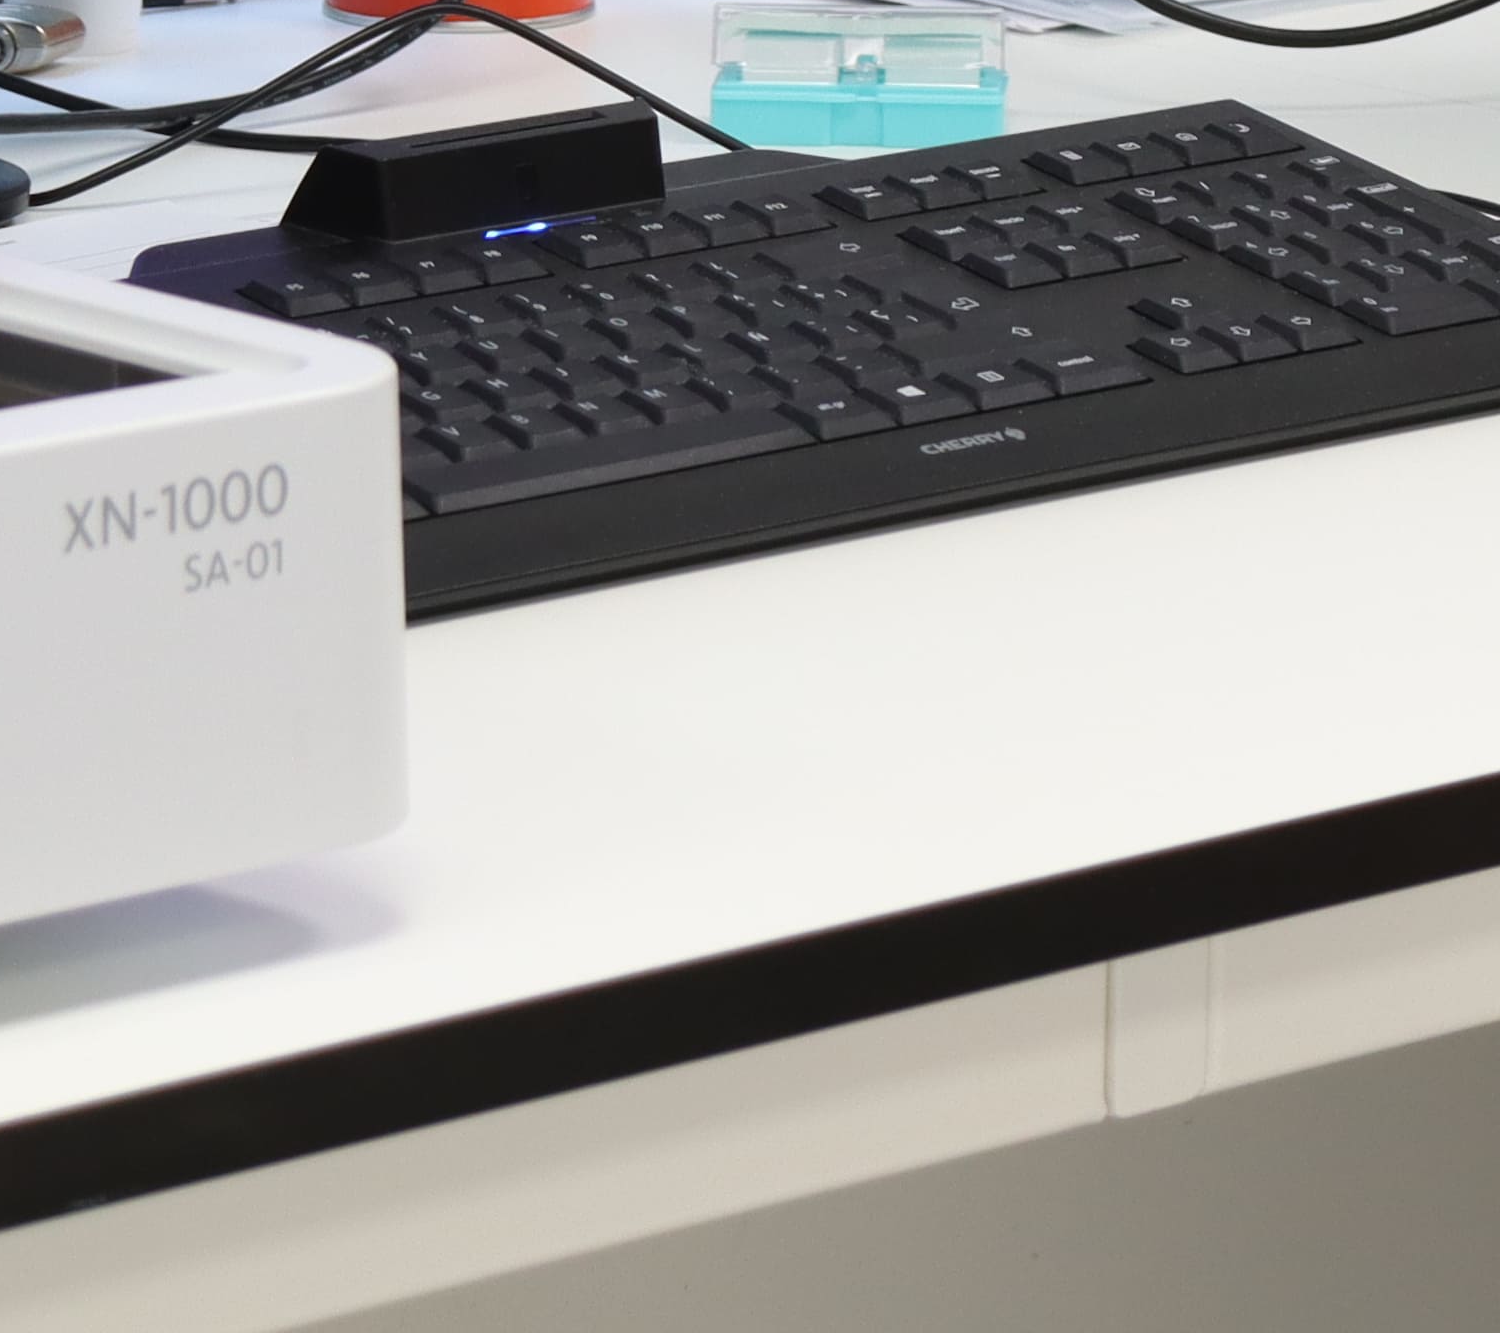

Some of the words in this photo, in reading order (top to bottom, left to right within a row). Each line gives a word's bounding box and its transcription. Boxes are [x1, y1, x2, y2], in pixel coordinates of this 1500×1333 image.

[478, 339, 500, 351] U
[409, 350, 429, 362] Y
[616, 354, 640, 365] K
[485, 377, 510, 390] H
[420, 390, 442, 402] G
[510, 413, 530, 425] B
[440, 425, 461, 437] V
[919, 430, 1005, 456] CHERRY
[63, 462, 288, 555] XN-1000
[183, 538, 284, 594] SA-01
